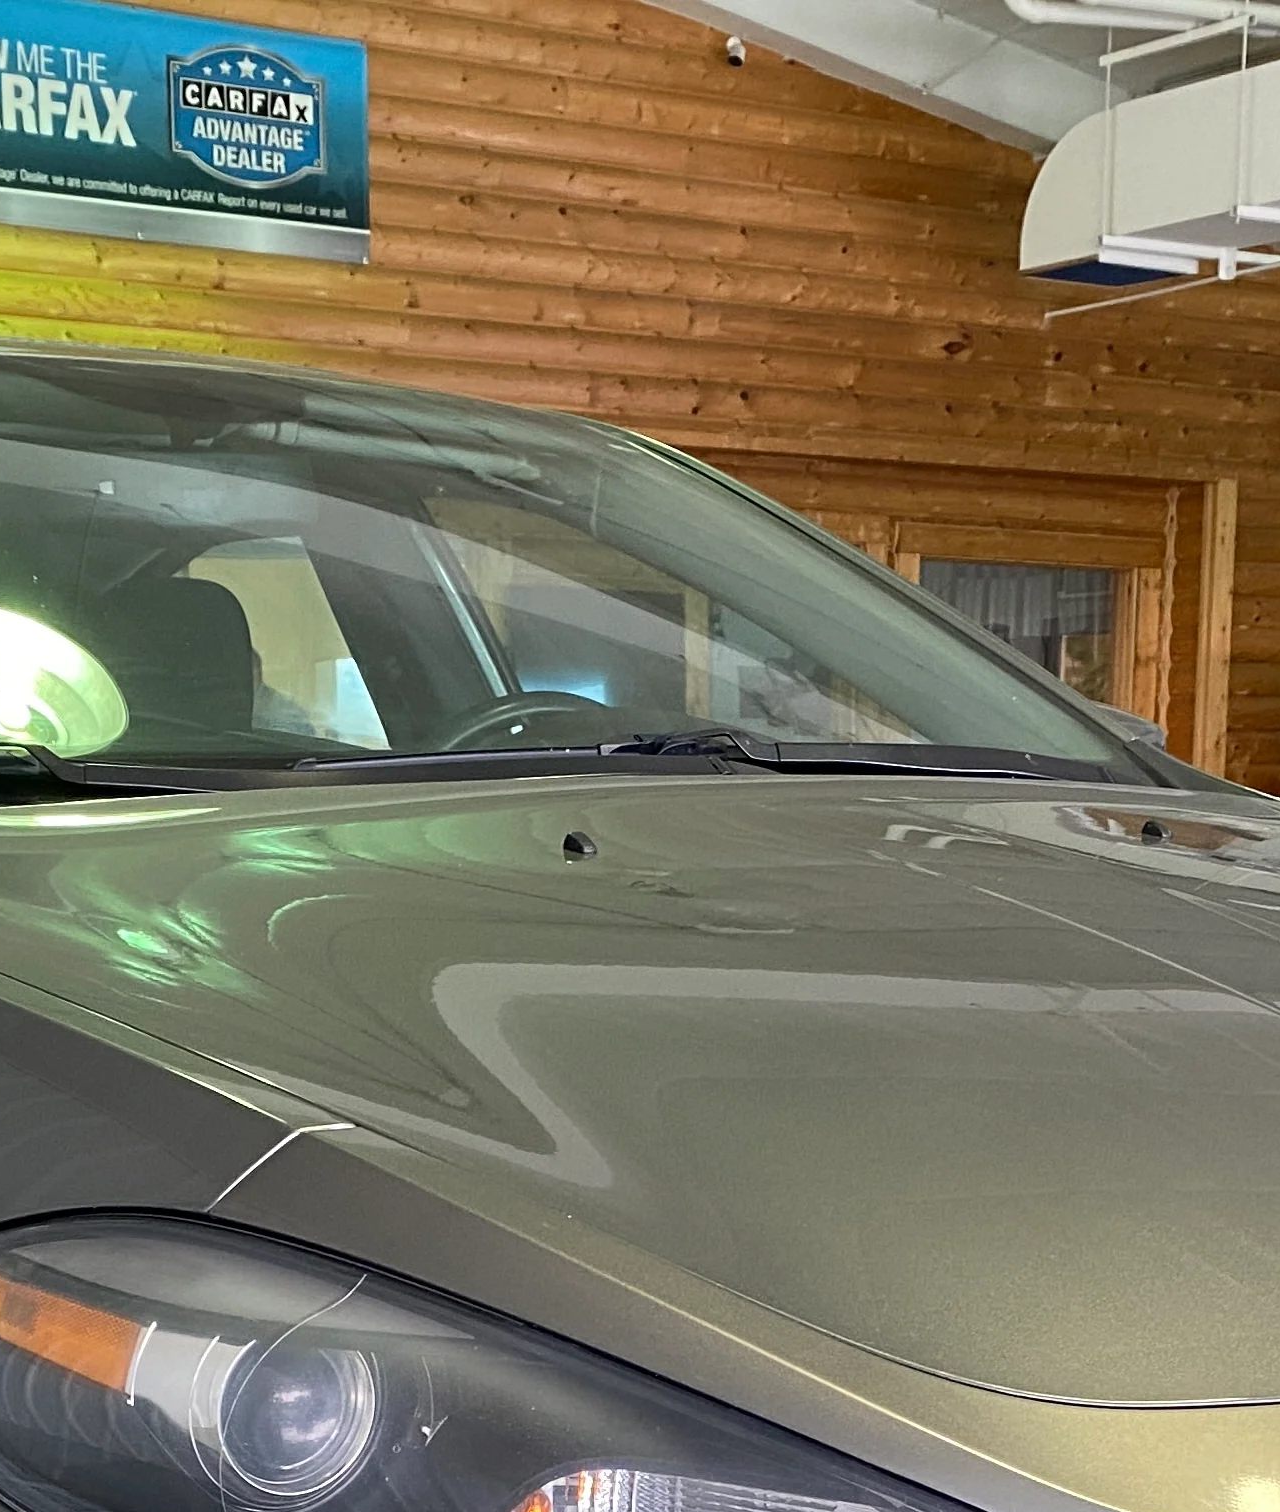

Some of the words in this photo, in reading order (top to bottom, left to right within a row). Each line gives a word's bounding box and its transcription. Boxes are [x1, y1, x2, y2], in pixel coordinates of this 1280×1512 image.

[16, 40, 56, 77] ME
[60, 46, 108, 85] THE
[184, 83, 309, 123] CARFAX
[192, 115, 305, 151] ADVANTAGE
[212, 143, 287, 175] DEALER
